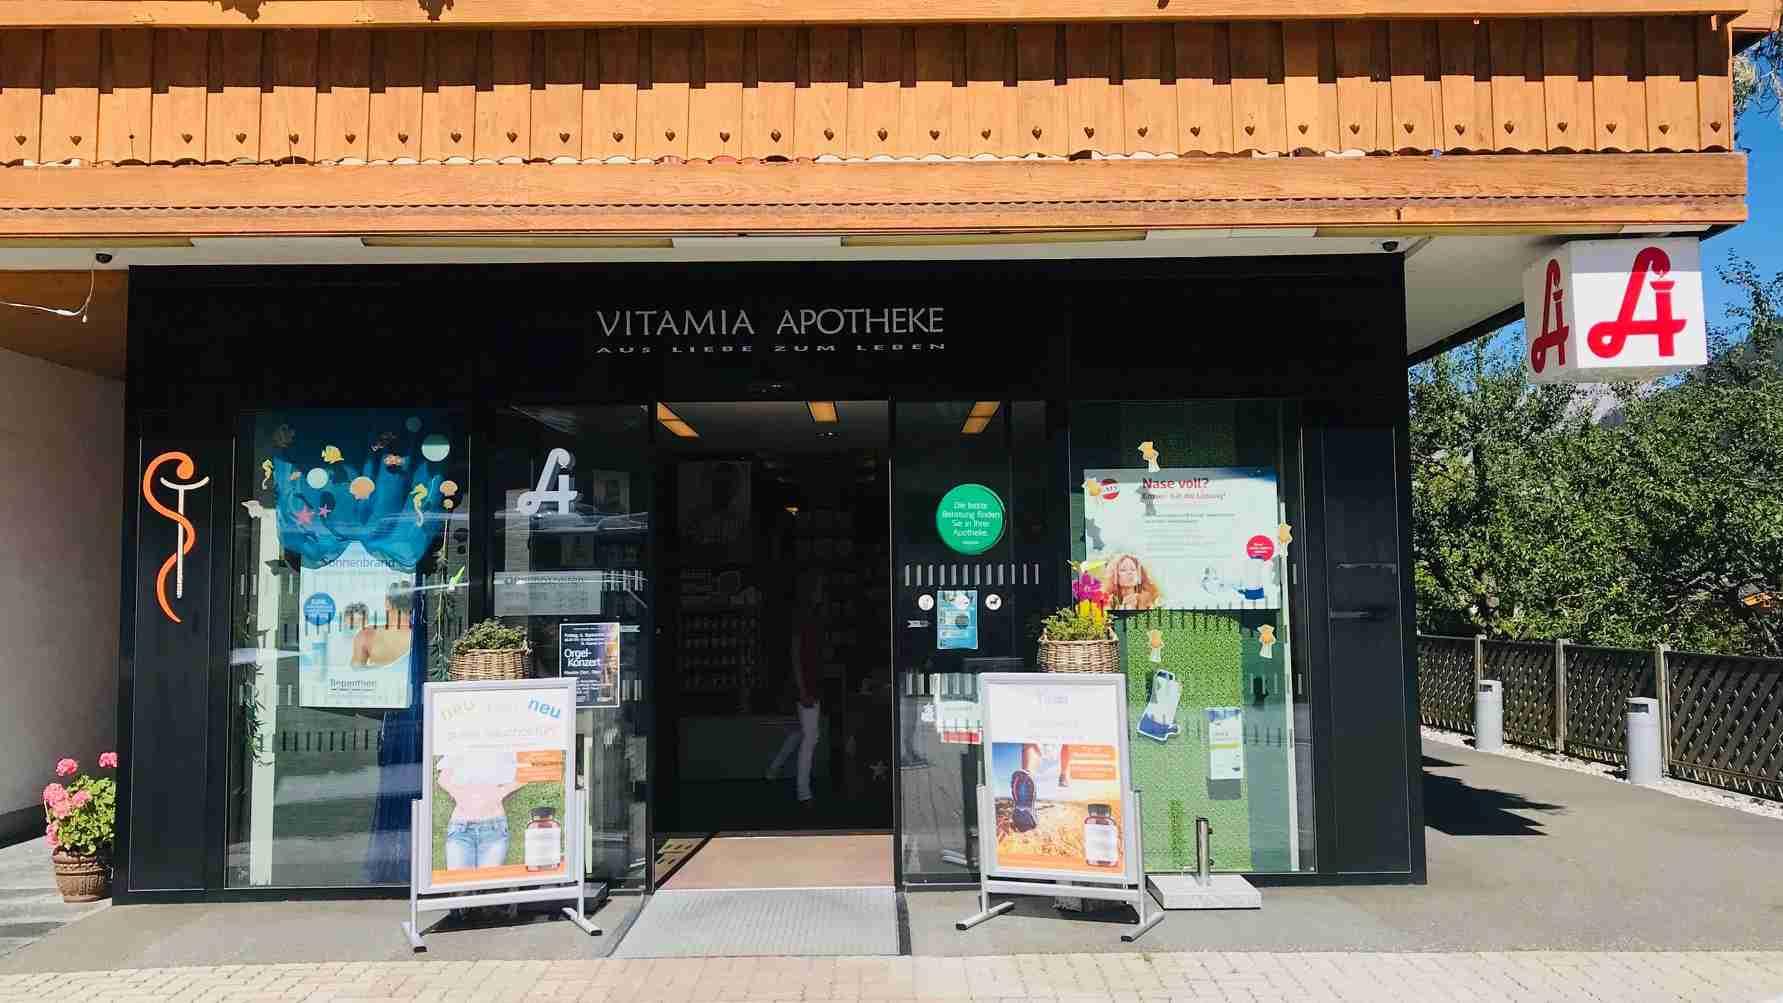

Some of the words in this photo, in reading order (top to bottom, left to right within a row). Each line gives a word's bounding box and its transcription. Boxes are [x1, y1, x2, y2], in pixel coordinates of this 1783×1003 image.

[596, 309, 755, 336] VITAMIA
[776, 307, 945, 335] APOTHEKE
[597, 345, 653, 353] AUS
[672, 344, 753, 353] LIEBE
[774, 343, 838, 352] ZUM
[856, 342, 946, 351] LEBEN
[1142, 477, 1176, 489] Nase
[1178, 476, 1210, 489] voll?
[953, 501, 966, 510] Die
[941, 510, 976, 520] Beratung
[977, 510, 1001, 520] finden
[951, 519, 964, 528] Sie
[965, 519, 973, 528] in
[974, 519, 990, 528] Ihrer
[320, 556, 398, 569] Sonnenbrand
[563, 648, 593, 660] Orgel-
[527, 696, 561, 719] neu
